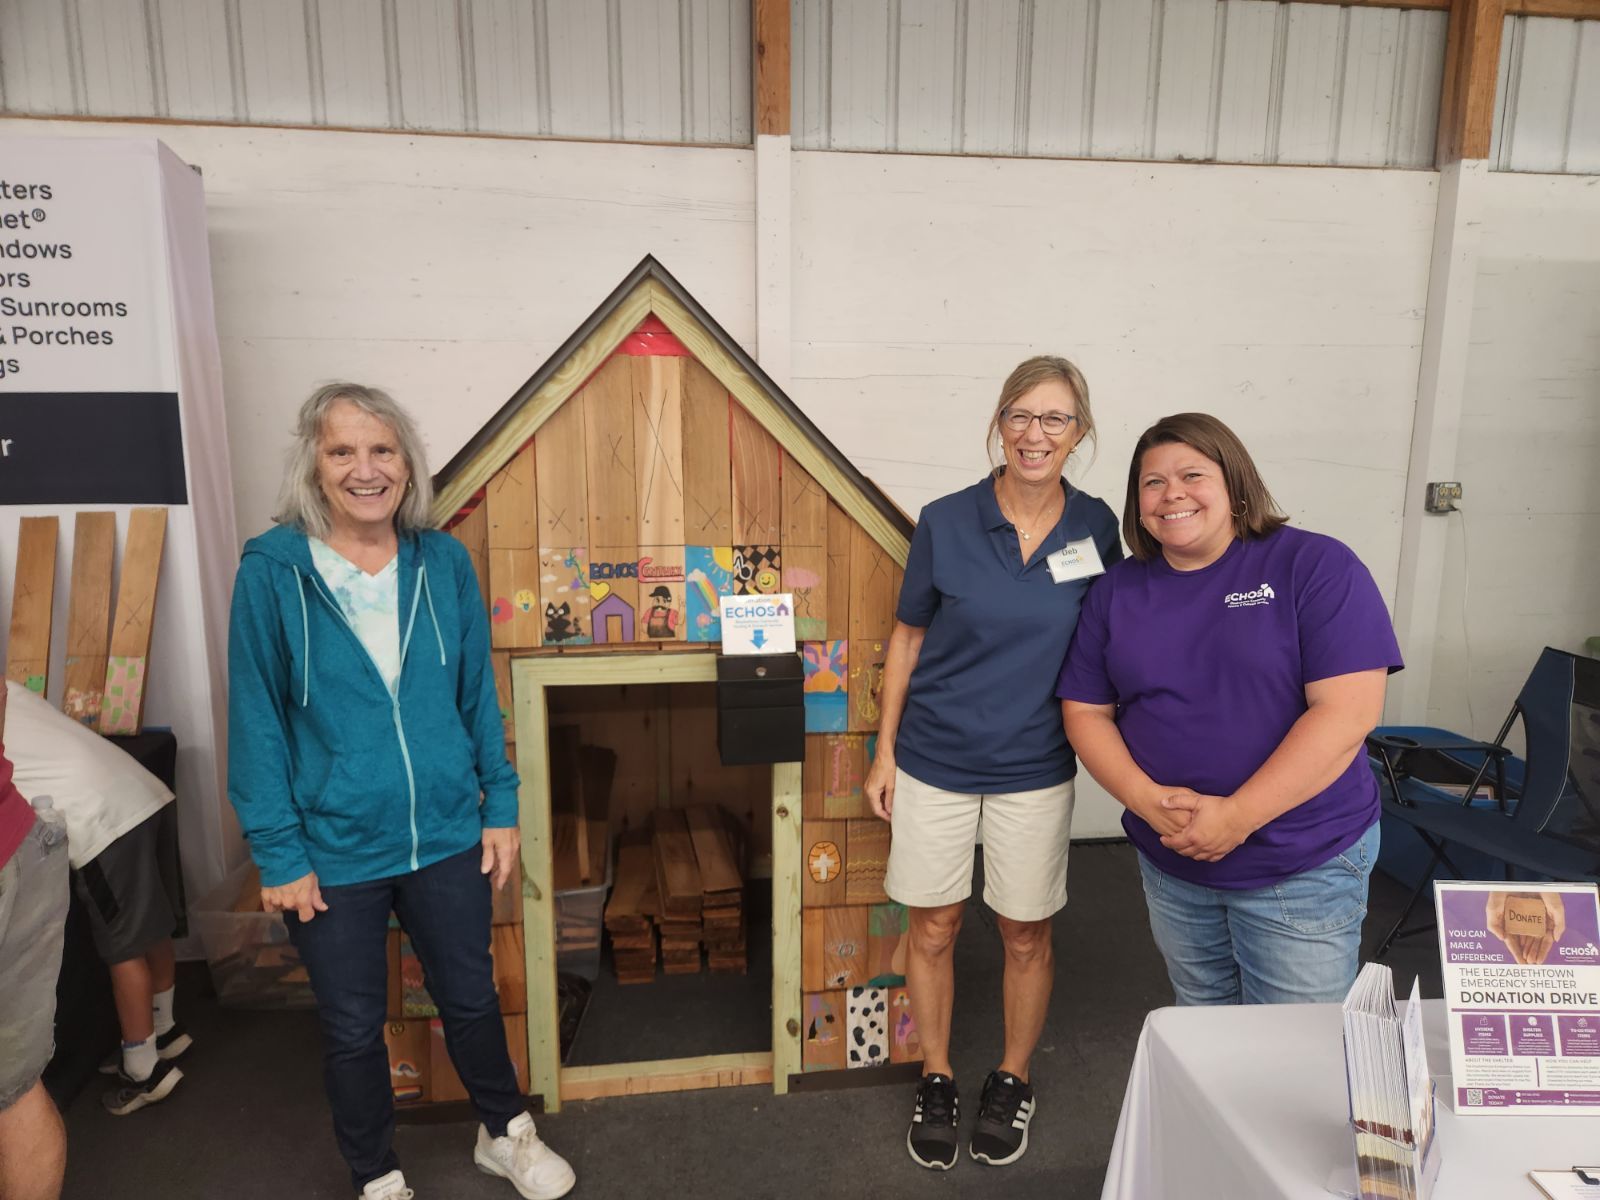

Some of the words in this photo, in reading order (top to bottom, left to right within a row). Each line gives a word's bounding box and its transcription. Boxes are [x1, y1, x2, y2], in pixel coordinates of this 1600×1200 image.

[0, 180, 52, 200] ters
[0, 208, 46, 229] et®
[1, 297, 127, 317] Sunrooms
[12, 326, 114, 345] Porches
[1062, 547, 1078, 556] Deb
[1225, 589, 1263, 603] ECHOS
[725, 605, 776, 618] ECHOS
[1449, 930, 1467, 938] YOU
[1469, 930, 1486, 938] CAN
[1450, 942, 1474, 950] MAKE
[1476, 942, 1483, 950] A
[1559, 947, 1591, 956] ECHOS
[1451, 953, 1504, 961] DIFFERENCE!
[1459, 968, 1480, 977] THE
[1483, 968, 1574, 977] ELIZABETHTOWN
[1461, 979, 1527, 988] EMERGENCY
[1529, 980, 1577, 988] SHELTER
[1461, 991, 1545, 1004] DONATION
[1550, 992, 1598, 1005] DRIVE
